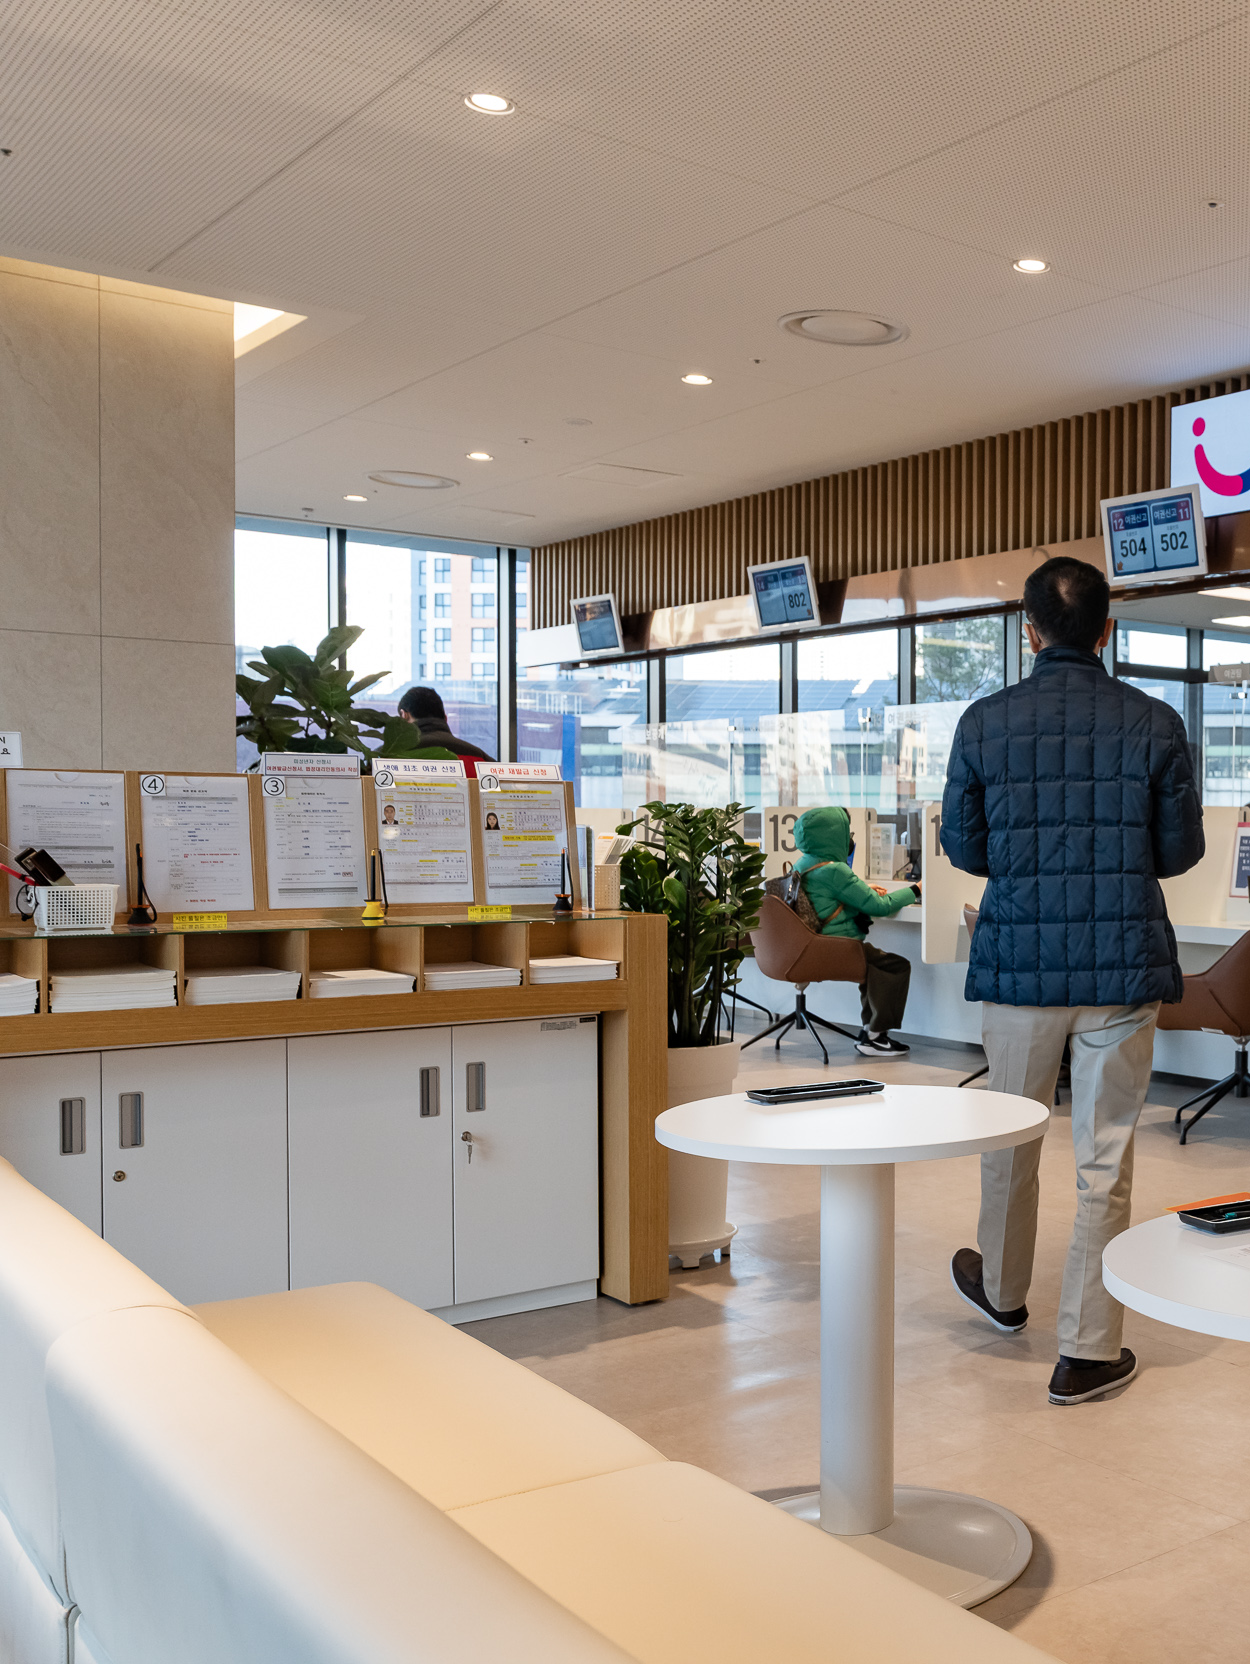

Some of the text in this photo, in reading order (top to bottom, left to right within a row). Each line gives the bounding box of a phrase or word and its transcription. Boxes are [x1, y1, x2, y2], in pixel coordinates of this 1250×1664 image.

[1179, 507, 1189, 519] 11
[1113, 518, 1124, 530] 12
[1120, 537, 1147, 557] 504
[1161, 531, 1189, 551] 502
[788, 592, 807, 608] 802
[403, 764, 418, 772] 최초
[422, 765, 437, 773] 여권
[441, 766, 457, 774] 신청
[490, 767, 547, 776] 여권 재발급 신청
[769, 814, 798, 852] 13
[930, 814, 947, 857] 1
